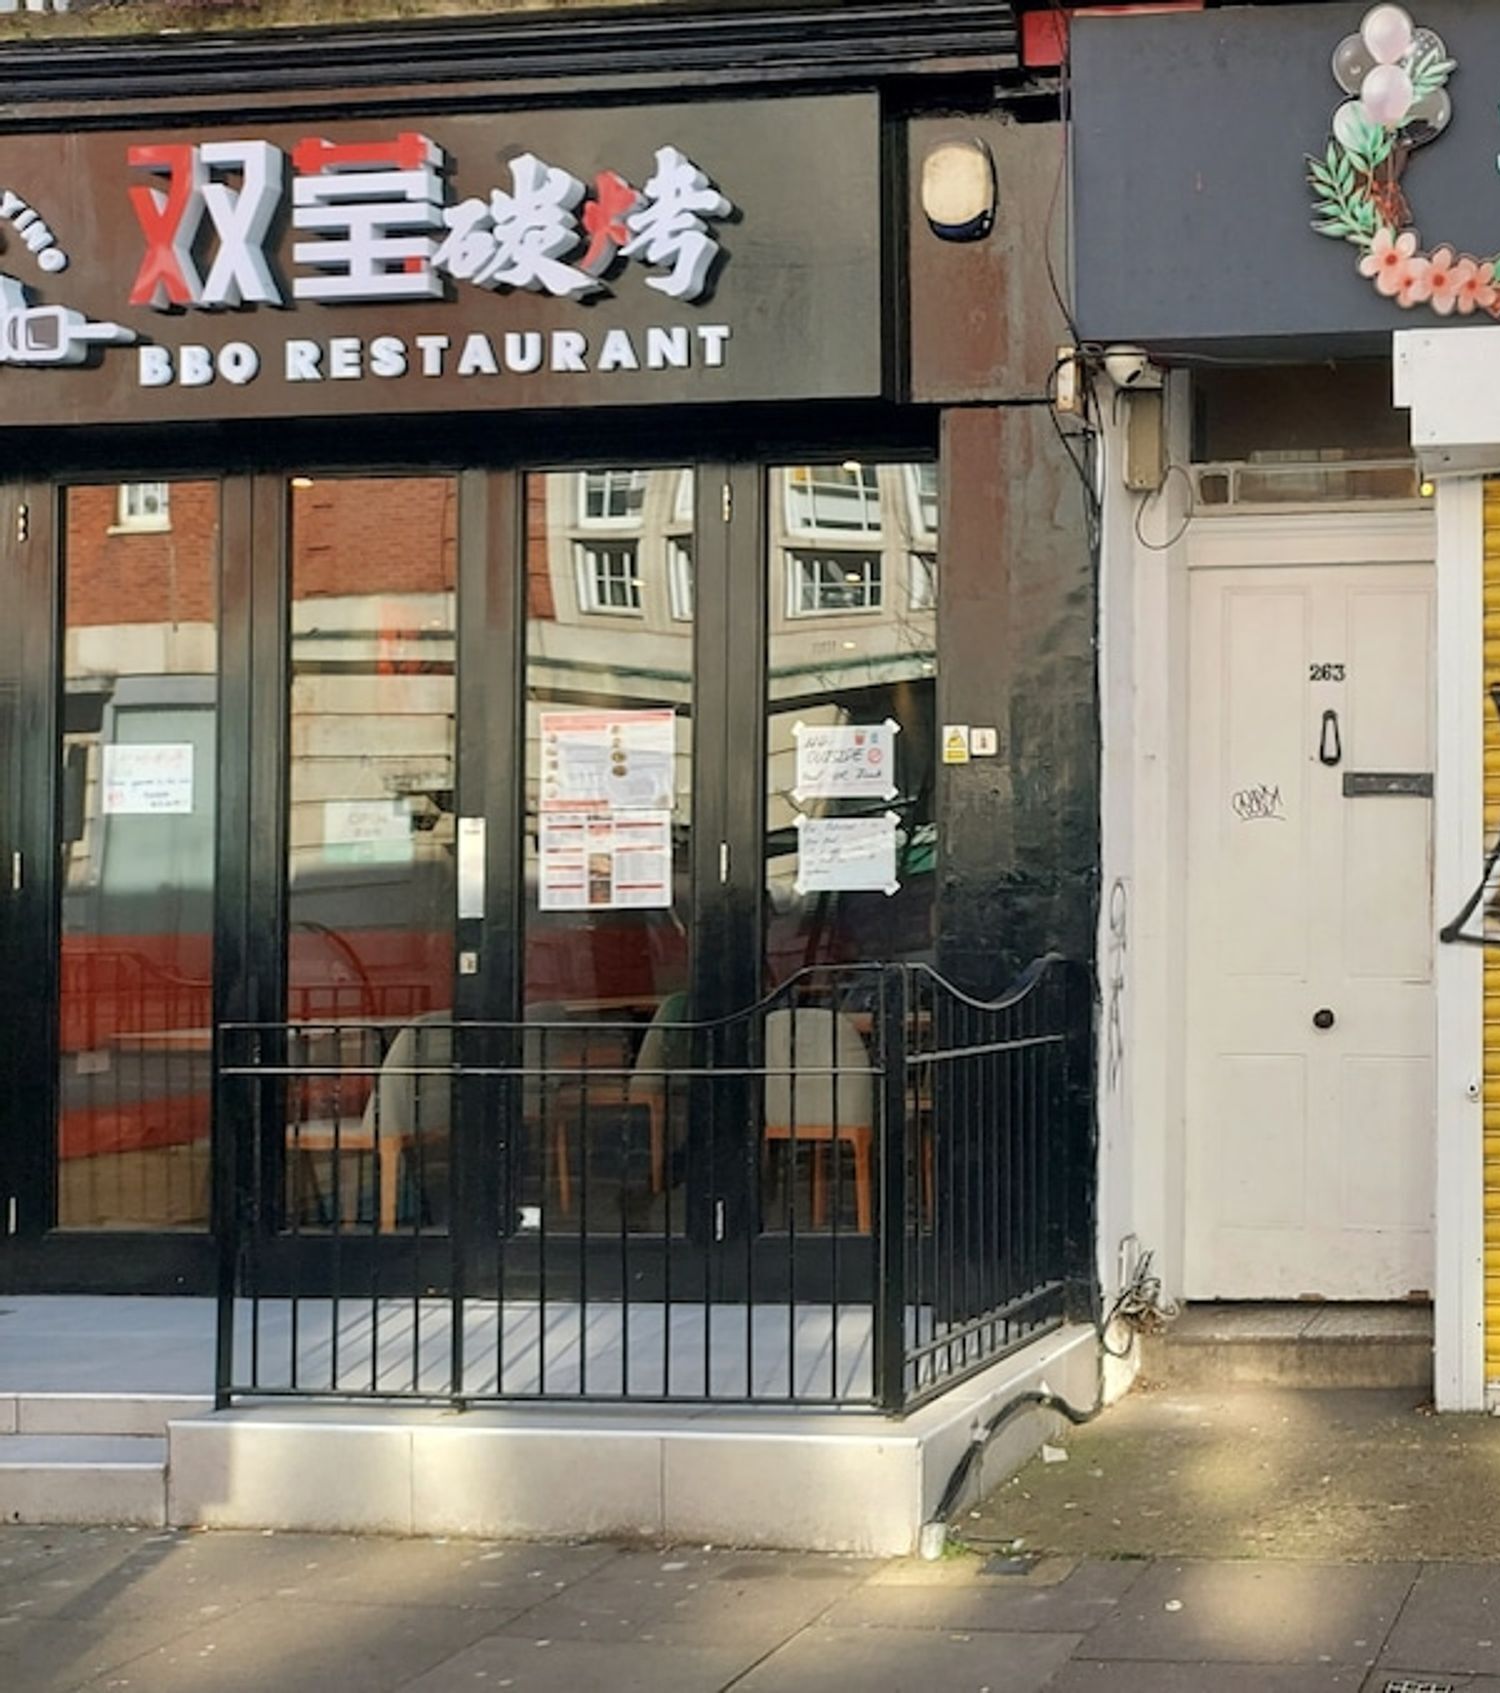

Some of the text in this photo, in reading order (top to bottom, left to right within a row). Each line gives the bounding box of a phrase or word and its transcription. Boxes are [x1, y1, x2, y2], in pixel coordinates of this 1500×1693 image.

[139, 324, 731, 387] BBQ RESTAURANT
[1309, 664, 1346, 681] 263
